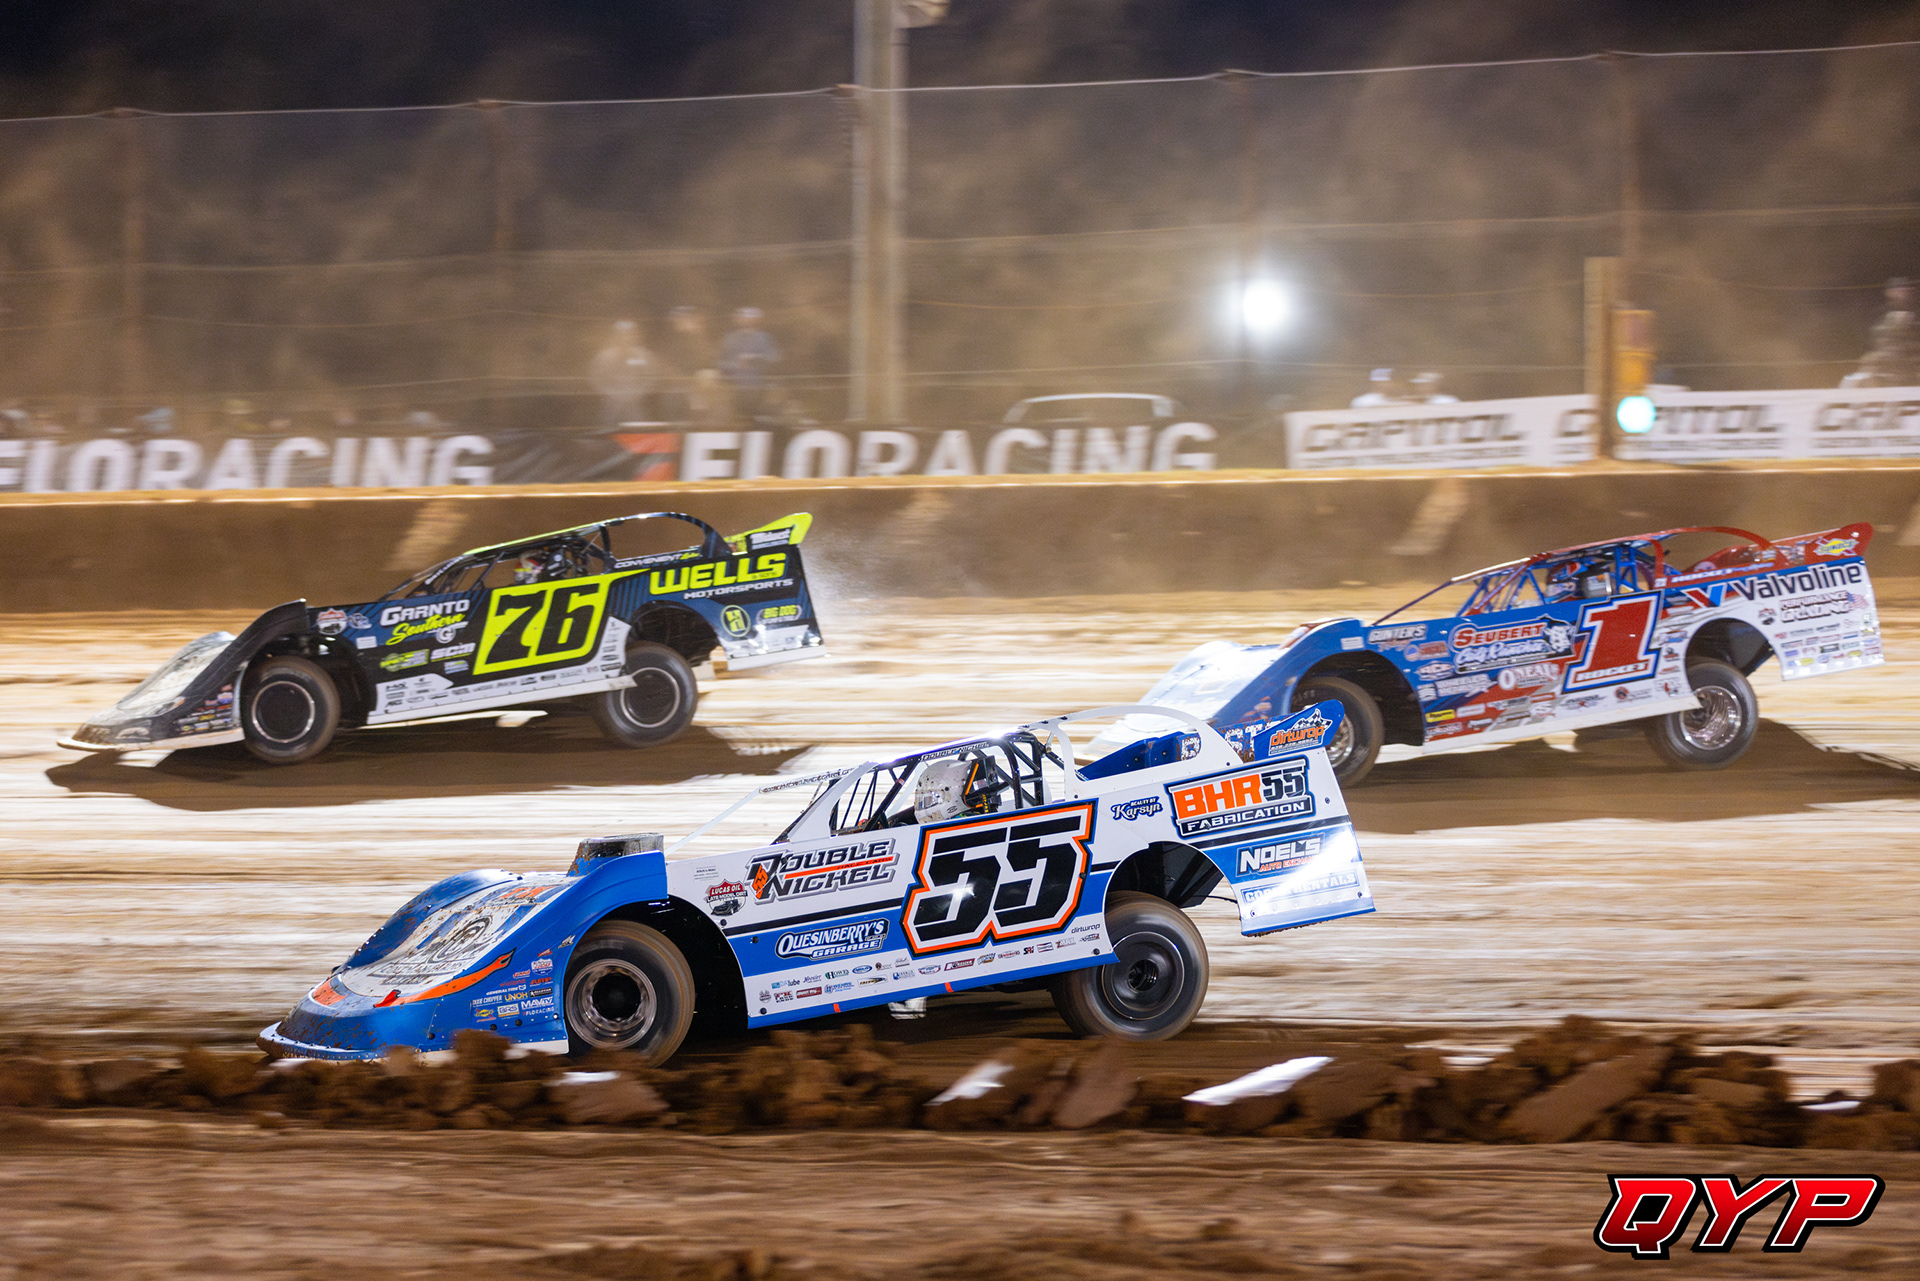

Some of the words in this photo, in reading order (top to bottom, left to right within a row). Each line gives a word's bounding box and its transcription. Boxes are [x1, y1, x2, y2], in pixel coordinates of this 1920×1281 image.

[650, 553, 787, 595] WELLS
[1731, 563, 1862, 600] Valvoline
[684, 579, 793, 600] MOTORSPORTS
[380, 599, 470, 627] GARNTO
[485, 583, 600, 665] 76
[385, 613, 466, 645] Southern
[1454, 623, 1546, 648] SEUBERT
[1570, 598, 1655, 685] 1
[1271, 726, 1324, 746] dirtwrap
[1112, 803, 1161, 819] Karsyn
[1187, 801, 1305, 831] FABRICATION
[748, 841, 890, 880] DOUBLE
[1240, 837, 1320, 873] NOEL'S
[1260, 861, 1281, 872] AUTO
[1283, 856, 1315, 867] EXCHAN
[711, 886, 730, 895] LUCAS
[732, 884, 740, 892] OIL
[760, 864, 890, 900] NICKEL
[913, 816, 1081, 942] 55
[778, 920, 885, 955] QUESINBERRY'S
[1071, 924, 1100, 933] dirtwrap
[812, 940, 880, 958] GARAGE
[504, 991, 528, 1001] UNOH
[526, 1007, 554, 1016] FLORACING
